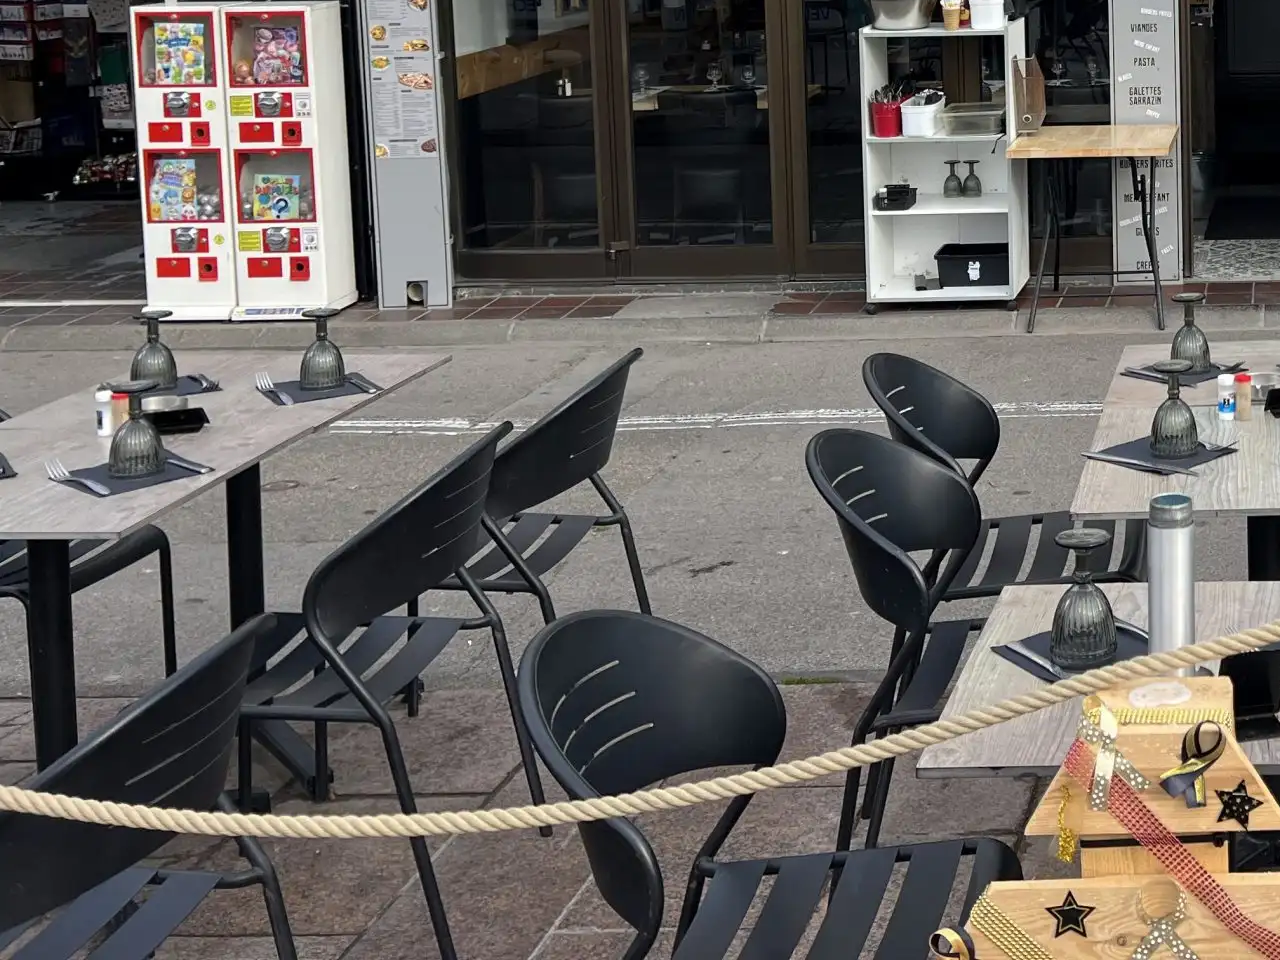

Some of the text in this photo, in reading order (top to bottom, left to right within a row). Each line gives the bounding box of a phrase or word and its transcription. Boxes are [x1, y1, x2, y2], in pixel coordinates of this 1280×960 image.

[1130, 23, 1158, 33] VIANDES
[1133, 57, 1156, 67] PASTA
[1129, 86, 1162, 96] GALETTES
[1129, 96, 1162, 106] SARRAZIN
